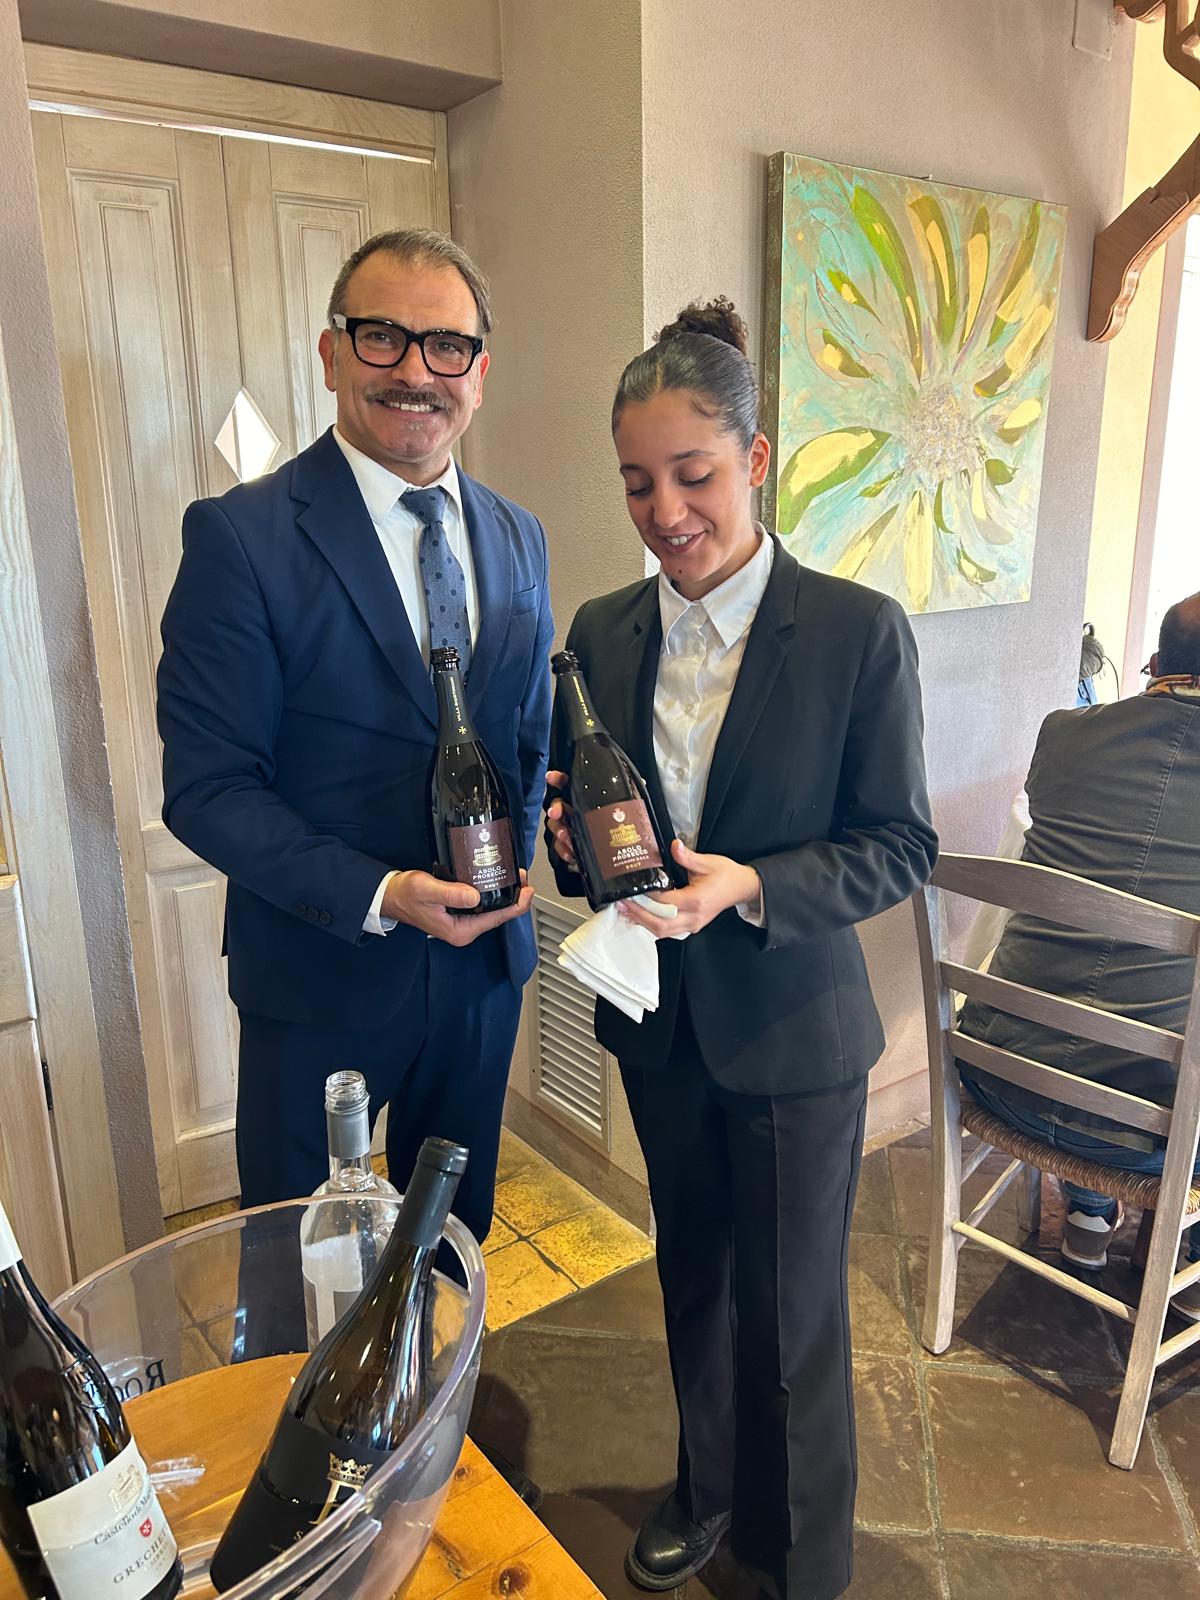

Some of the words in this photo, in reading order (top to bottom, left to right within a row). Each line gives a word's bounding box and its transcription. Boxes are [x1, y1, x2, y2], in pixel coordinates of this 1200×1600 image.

[612, 849, 648, 862] PROSECCO
[617, 845, 642, 856] ASOLO
[473, 869, 506, 880] PROSECCO
[478, 866, 501, 875] ASOLO
